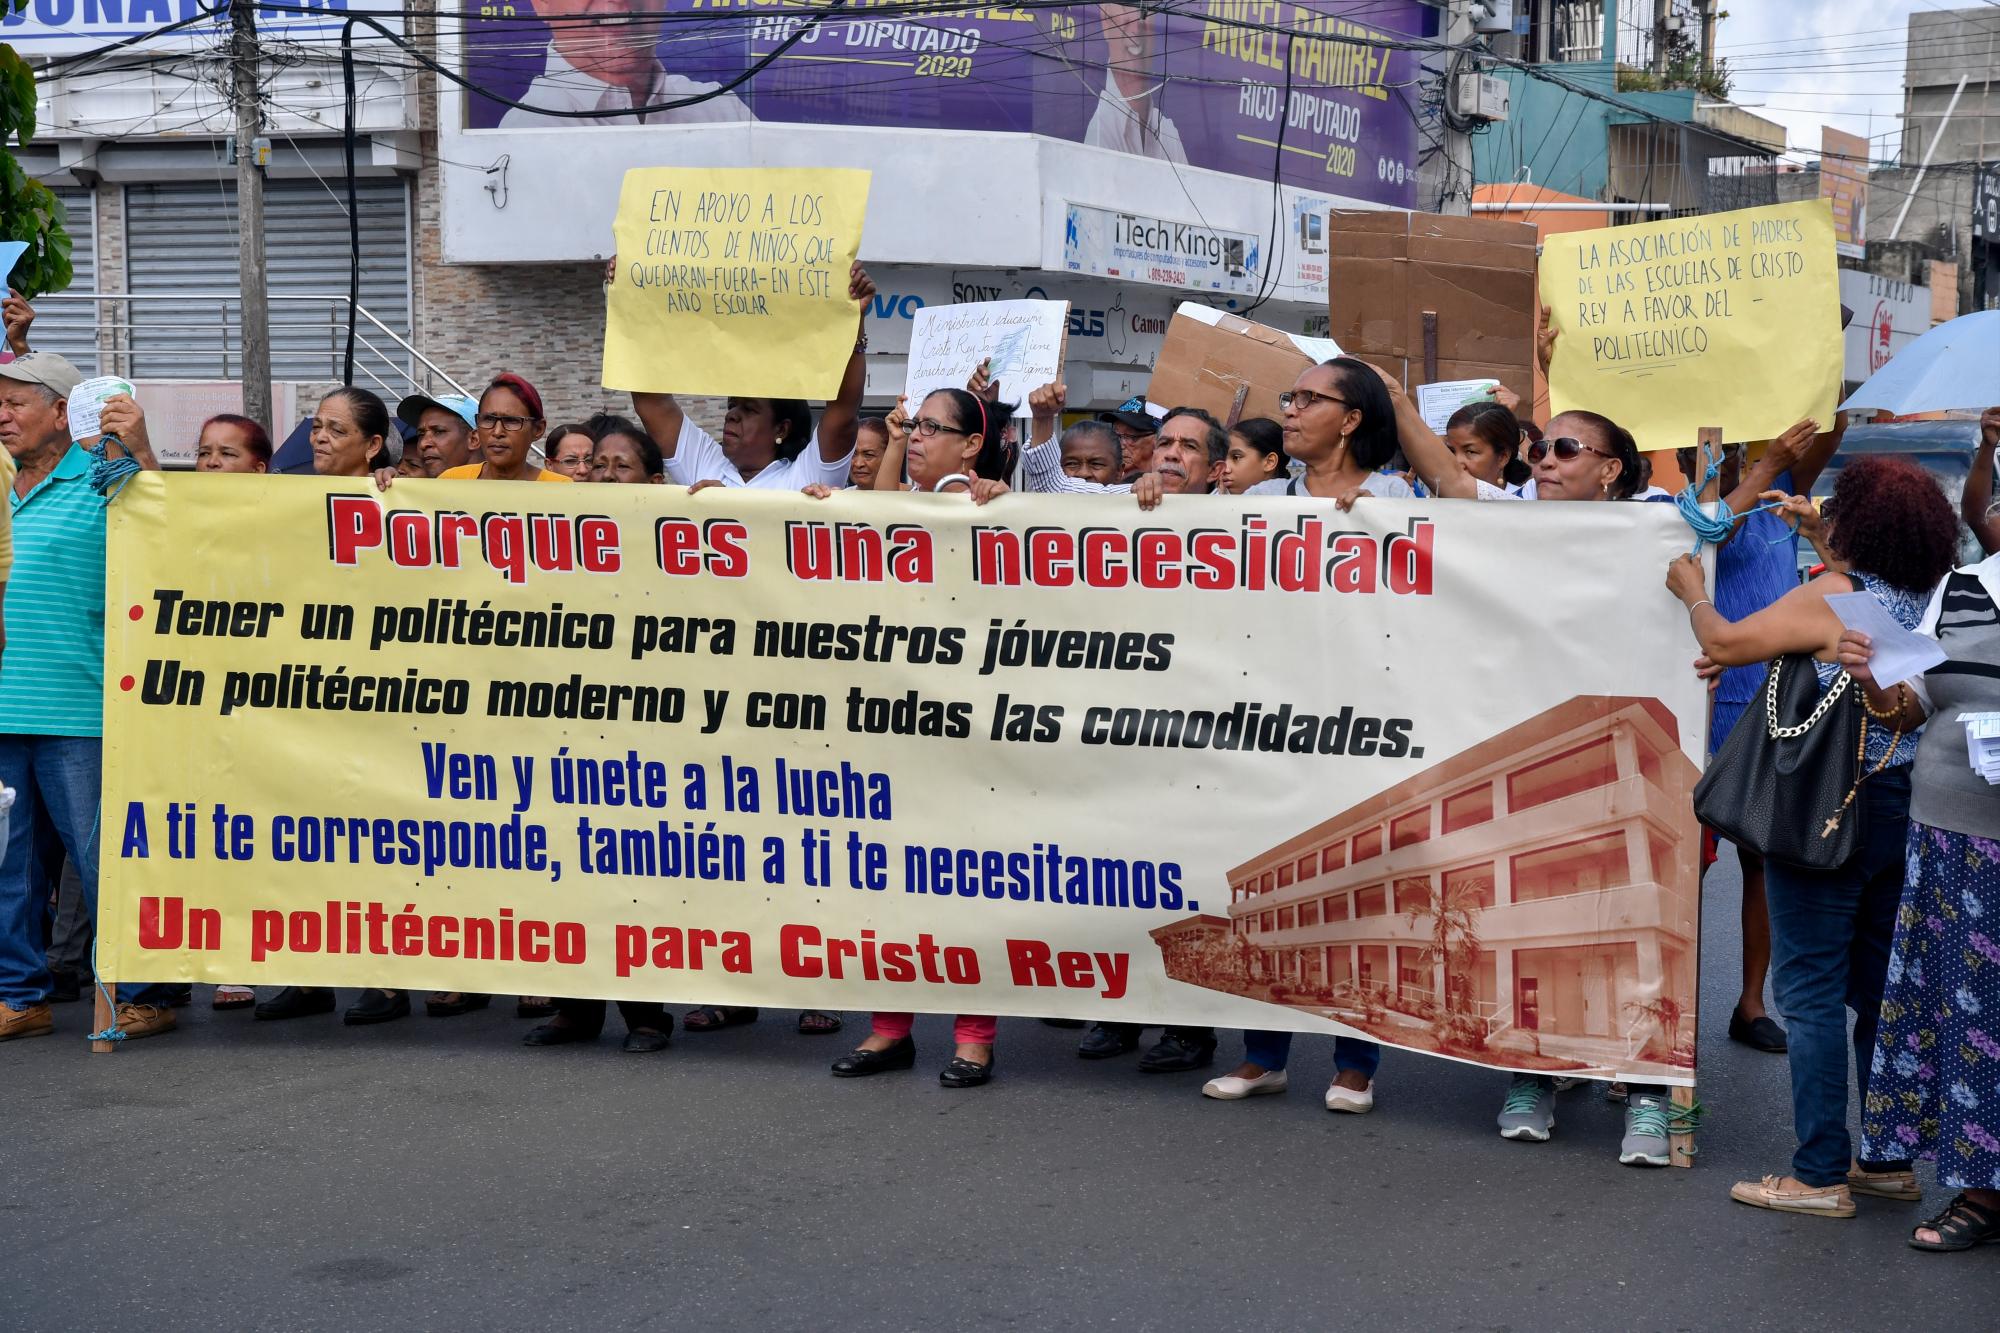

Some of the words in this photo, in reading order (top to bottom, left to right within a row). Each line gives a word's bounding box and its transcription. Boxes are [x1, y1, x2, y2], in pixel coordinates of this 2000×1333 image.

[752, 16, 821, 44] RICO
[845, 21, 981, 54] DIPUTADO
[1051, 12, 1076, 40] PLD
[914, 54, 973, 78] 2020
[1238, 77, 1277, 122] RICO
[1288, 90, 1361, 143] DIPUTADO
[1325, 143, 1356, 178] 2020
[650, 190, 681, 223] EN
[694, 192, 751, 224] APOYO
[762, 193, 775, 224] A
[789, 194, 823, 226] LOS
[646, 229, 710, 259] CIENTOS
[724, 230, 743, 259] DE
[749, 227, 798, 263] NIÑOS
[804, 236, 835, 267] QUE
[1174, 222, 1220, 265] King
[1579, 243, 1601, 270] LA
[1609, 222, 1712, 267] ASOCIACIÓN
[1723, 223, 1741, 249] DE
[1752, 219, 1803, 245] PADRES
[799, 267, 831, 298] ESTE
[1578, 277, 1595, 295] DE
[1606, 271, 1636, 295] LAS
[1646, 257, 1722, 293] ESCUELAS
[1727, 256, 1742, 281] DE
[1751, 251, 1804, 280] CRISTO
[1870, 275, 1913, 303] TEMPLO
[668, 286, 701, 314] AÑO
[953, 283, 1002, 304] SONY
[1579, 302, 1607, 328] REY
[1623, 299, 1636, 323] A
[1644, 294, 1699, 323] FAVOR
[1705, 289, 1733, 318] DEL
[1069, 308, 1105, 337] SUS
[1131, 313, 1165, 335] Canon
[956, 333, 976, 363] Rey
[1593, 323, 1708, 362] POLITECNICO
[913, 359, 946, 381] derecho
[183, 449, 192, 459] de
[327, 493, 620, 582] Porque
[655, 517, 747, 576] es
[785, 521, 933, 582] una
[971, 514, 1433, 594] necesidad
[154, 590, 284, 637] Tener
[301, 604, 353, 640] un
[370, 599, 614, 650] politécnico
[632, 616, 735, 659] para
[754, 615, 965, 664] nuestros
[979, 619, 1174, 675] jóvenes
[141, 660, 204, 705] Un
[220, 664, 469, 715] politécnico
[487, 674, 685, 723] moderno
[701, 690, 729, 733] y
[746, 692, 826, 730] con
[847, 687, 972, 738] todas
[991, 694, 1064, 742] las
[1081, 702, 1424, 758] comodidades.
[423, 743, 496, 800] Ven
[514, 757, 533, 811] y
[552, 748, 666, 807] únete
[685, 764, 706, 809] a
[723, 756, 759, 812] la
[776, 758, 891, 820] lucha
[123, 803, 148, 857] A
[168, 804, 194, 858] ti
[214, 804, 253, 860] te
[273, 814, 560, 880] corresponde,
[578, 817, 744, 880] también
[764, 837, 784, 883] a
[802, 829, 830, 886] ti
[848, 832, 886, 890] te
[906, 844, 1198, 910] necesitamos.
[140, 897, 221, 950] Un
[252, 901, 586, 964] politécnico
[616, 925, 752, 976] para
[781, 925, 980, 983] Cristo
[1008, 940, 1128, 998] Rey
